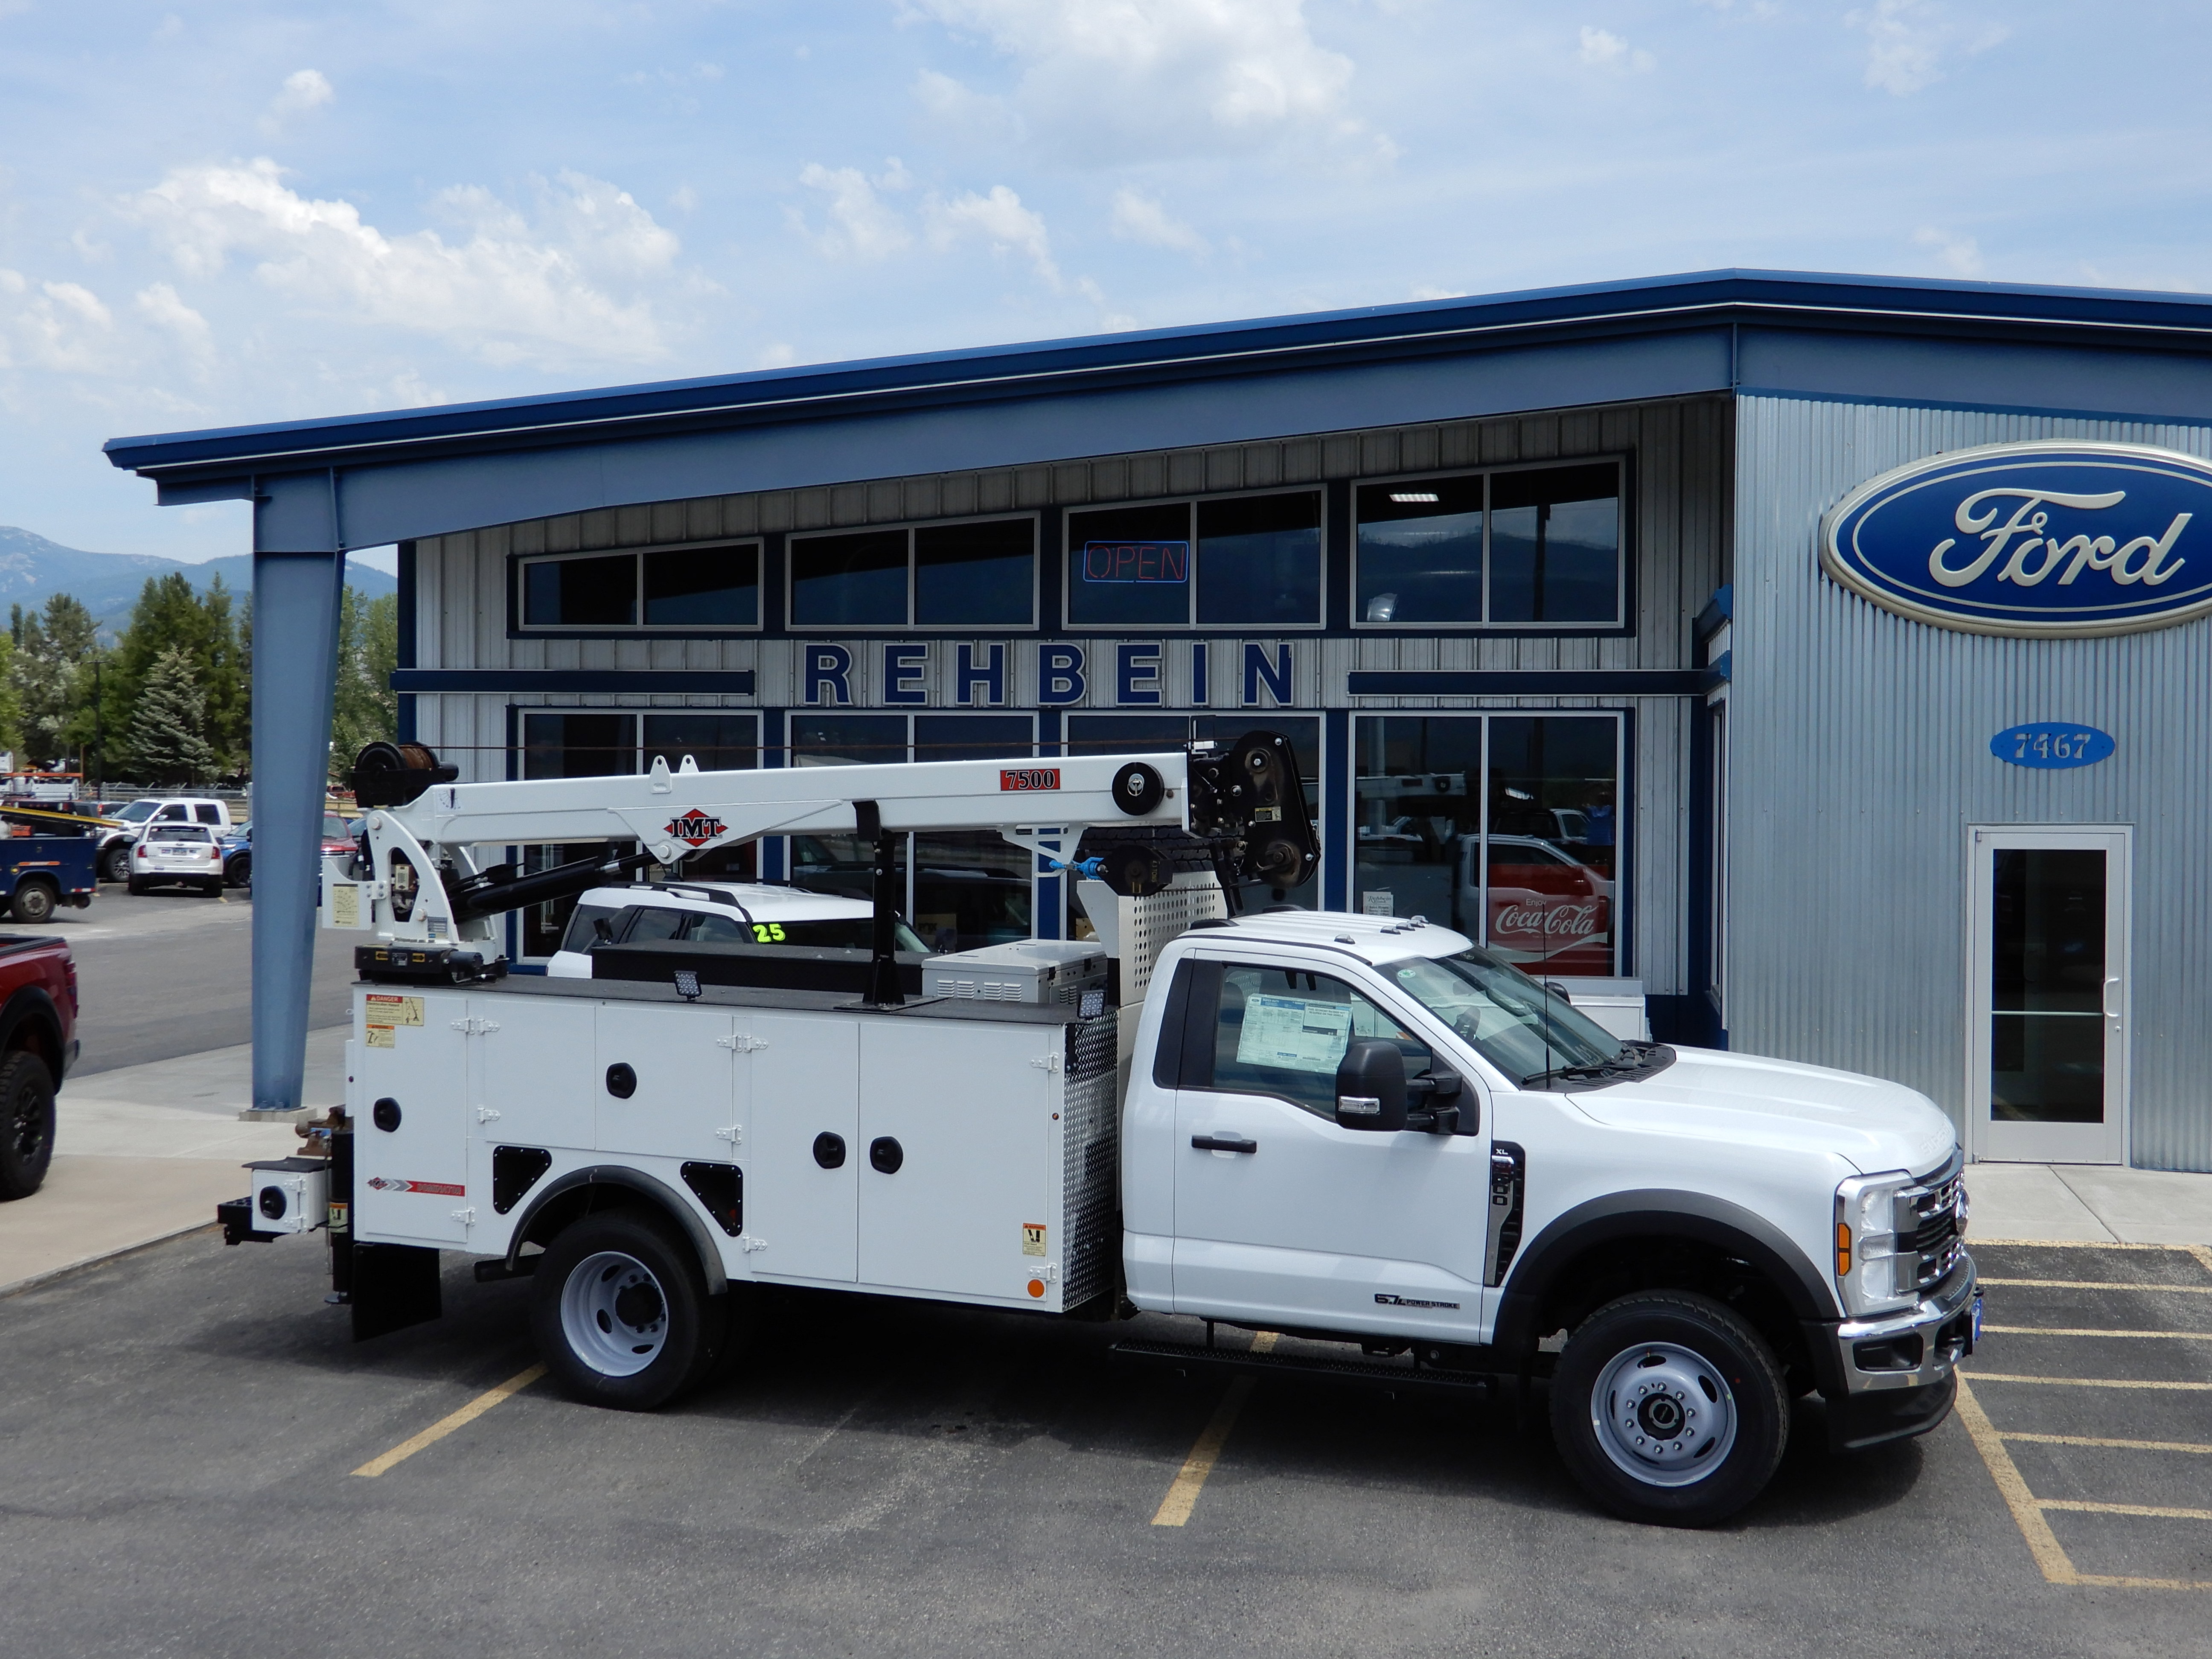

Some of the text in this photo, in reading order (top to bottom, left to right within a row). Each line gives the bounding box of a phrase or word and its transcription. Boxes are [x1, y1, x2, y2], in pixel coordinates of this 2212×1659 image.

[1929, 488, 2193, 588] Ford
[1088, 545, 1185, 579] OPEN
[803, 641, 1295, 707] REHBEIN
[2014, 733, 2092, 759] 7467
[1005, 770, 1055, 789] 7500
[670, 817, 721, 839] IMT
[1526, 899, 1547, 907] Enjoy
[1496, 905, 1599, 934] Coca-Cola
[753, 923, 786, 943] 25
